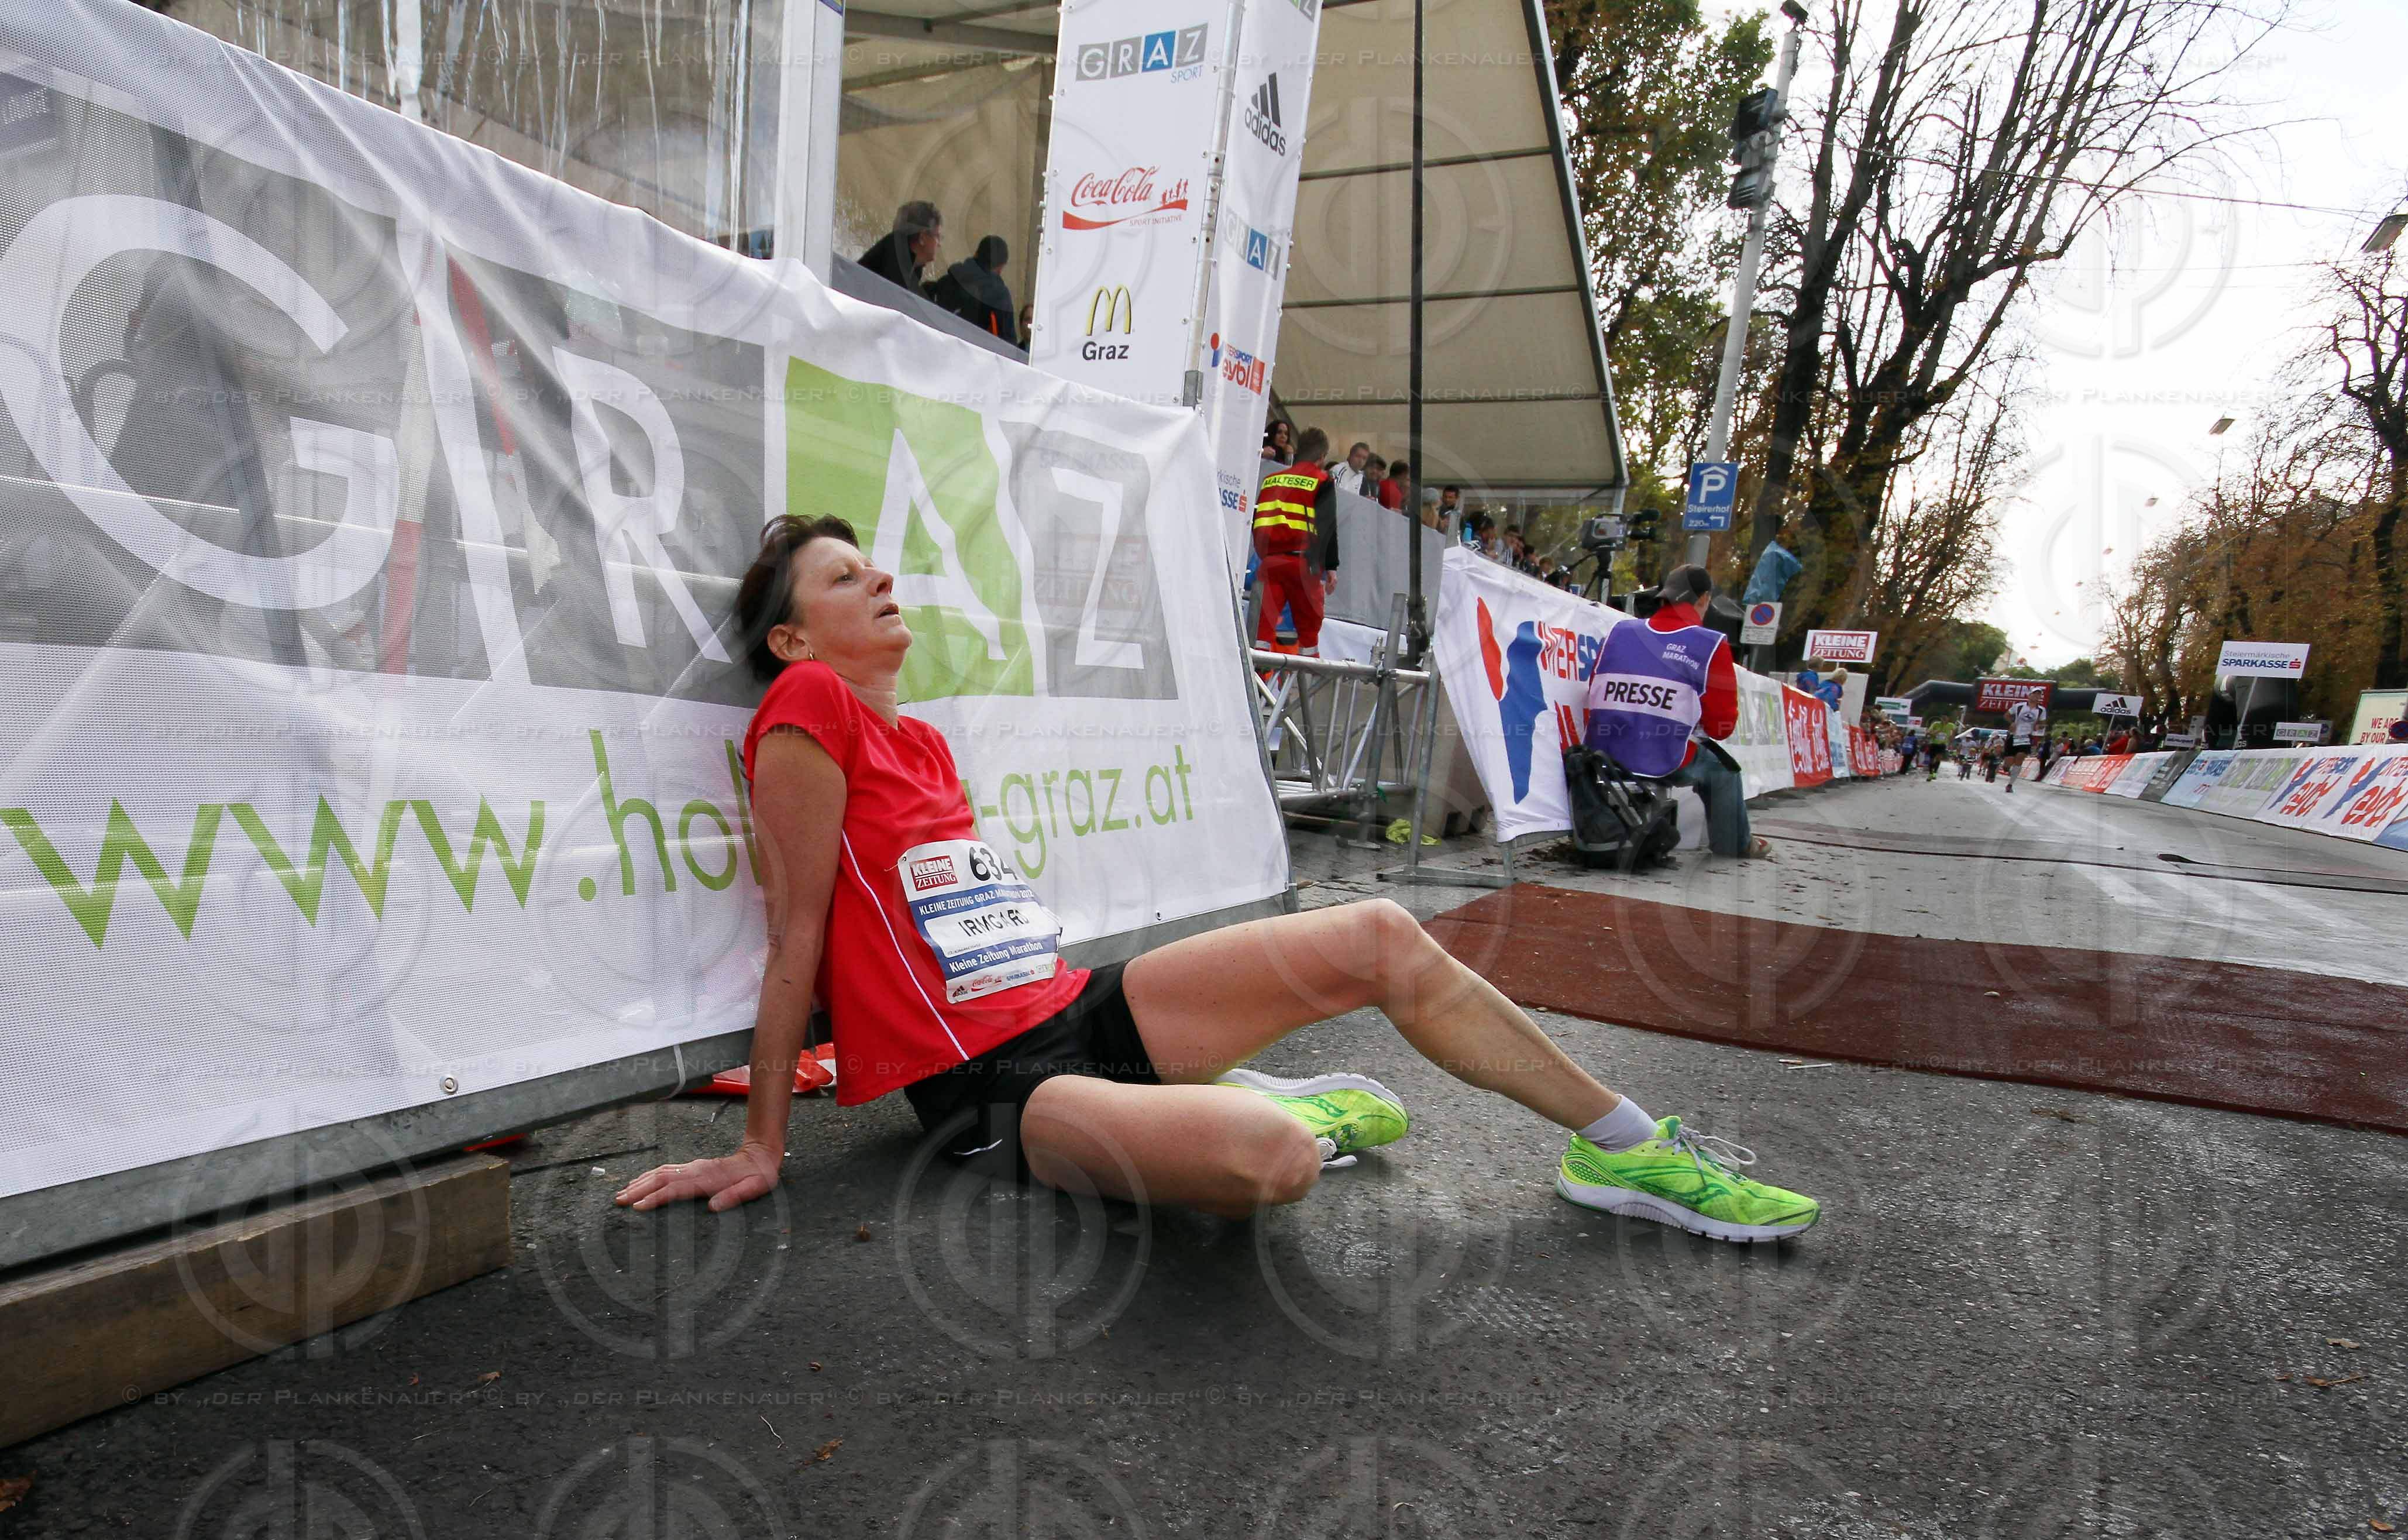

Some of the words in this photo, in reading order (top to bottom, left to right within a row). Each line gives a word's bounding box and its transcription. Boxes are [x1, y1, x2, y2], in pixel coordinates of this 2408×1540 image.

[1080, 32, 1200, 77] GRAZ
[1171, 68, 1203, 84] SPORT
[1244, 106, 1286, 157] adidas
[1129, 218, 1151, 226] SPORT
[1151, 215, 1182, 225] INITIATIVE
[1082, 341, 1129, 361] Graz
[1222, 358, 1251, 388] eybl
[0, 194, 1144, 669] GRAZ
[1264, 475, 1315, 489] MALTESER
[1687, 504, 1731, 513] Steirerhof
[1667, 643, 1687, 654] GRAZ
[1814, 634, 1867, 648] KLEINE
[1662, 651, 1700, 670] MARATHON
[1813, 648, 1864, 658] ZEITUNG
[2222, 658, 2289, 669] SPARKASSE
[1604, 681, 1677, 710] PRESSE
[2100, 707, 2131, 715] adidas
[2371, 718, 2383, 728] WE
[2360, 732, 2371, 743] BY
[2371, 732, 2386, 743] OUR
[913, 858, 952, 875] KLEINE
[916, 872, 956, 888] ZEITUNG
[919, 900, 947, 916] KLEINE
[947, 895, 974, 908] ZEITUNG
[974, 889, 996, 903] GRAZ
[949, 957, 978, 973] Kleine
[977, 948, 1011, 965] Zeitung
[1008, 940, 1044, 955] Marathon
